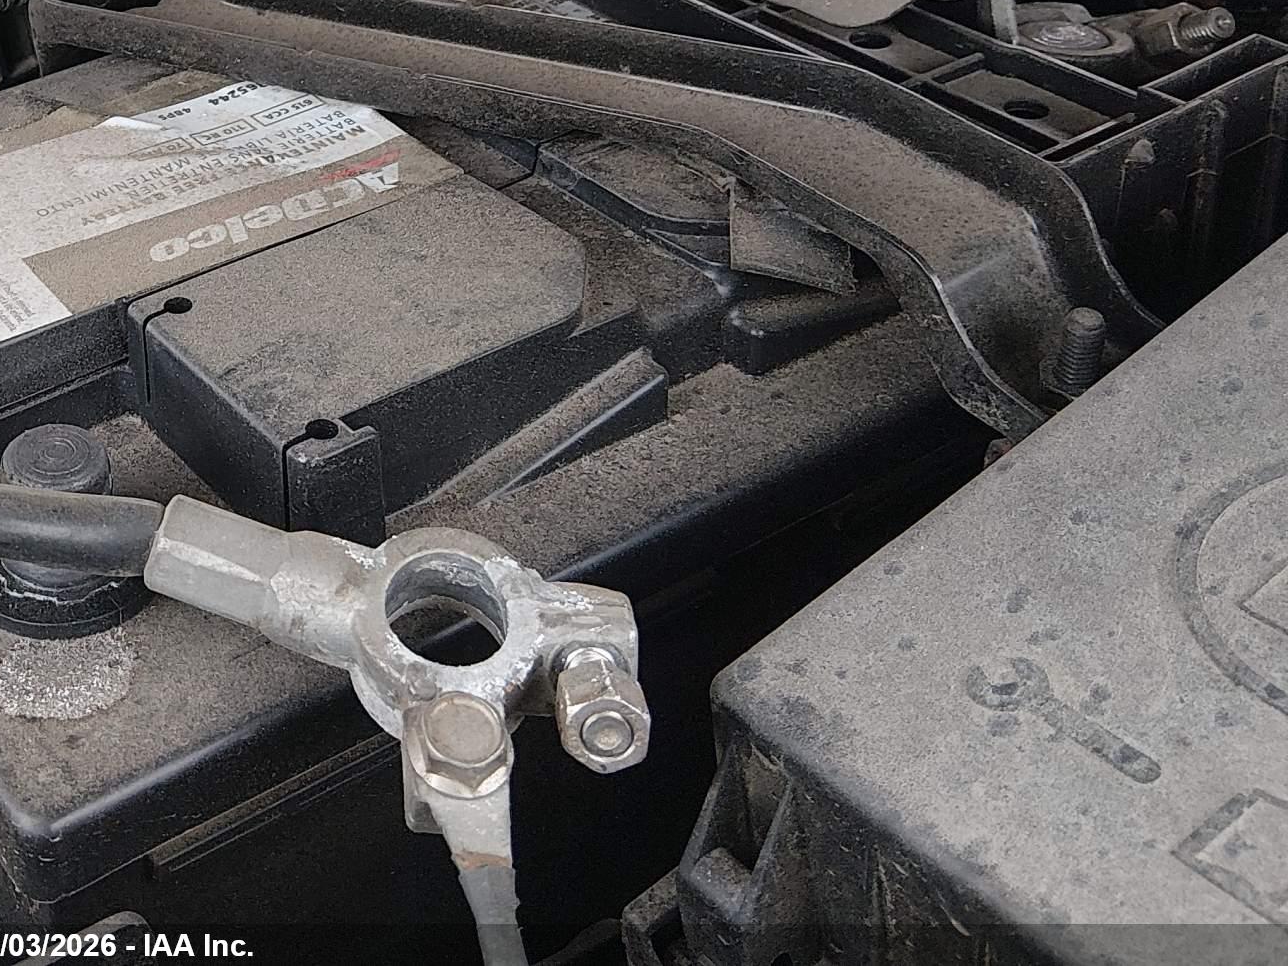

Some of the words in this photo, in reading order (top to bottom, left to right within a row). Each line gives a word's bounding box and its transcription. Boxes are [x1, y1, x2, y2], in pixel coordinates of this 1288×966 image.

[290, 98, 315, 110] 615
[156, 107, 193, 120] 48PS
[261, 107, 292, 120] CCA
[220, 124, 246, 134] 110
[273, 110, 345, 140] BATERÍA
[275, 117, 355, 150] BATTERIE
[201, 132, 221, 141] RC
[225, 147, 275, 160] SANS
[33, 157, 192, 217] MANTENIMIENTO
[122, 158, 226, 200] ENTRETIEN
[169, 173, 221, 194] FREE
[152, 161, 399, 264] ACDelco
